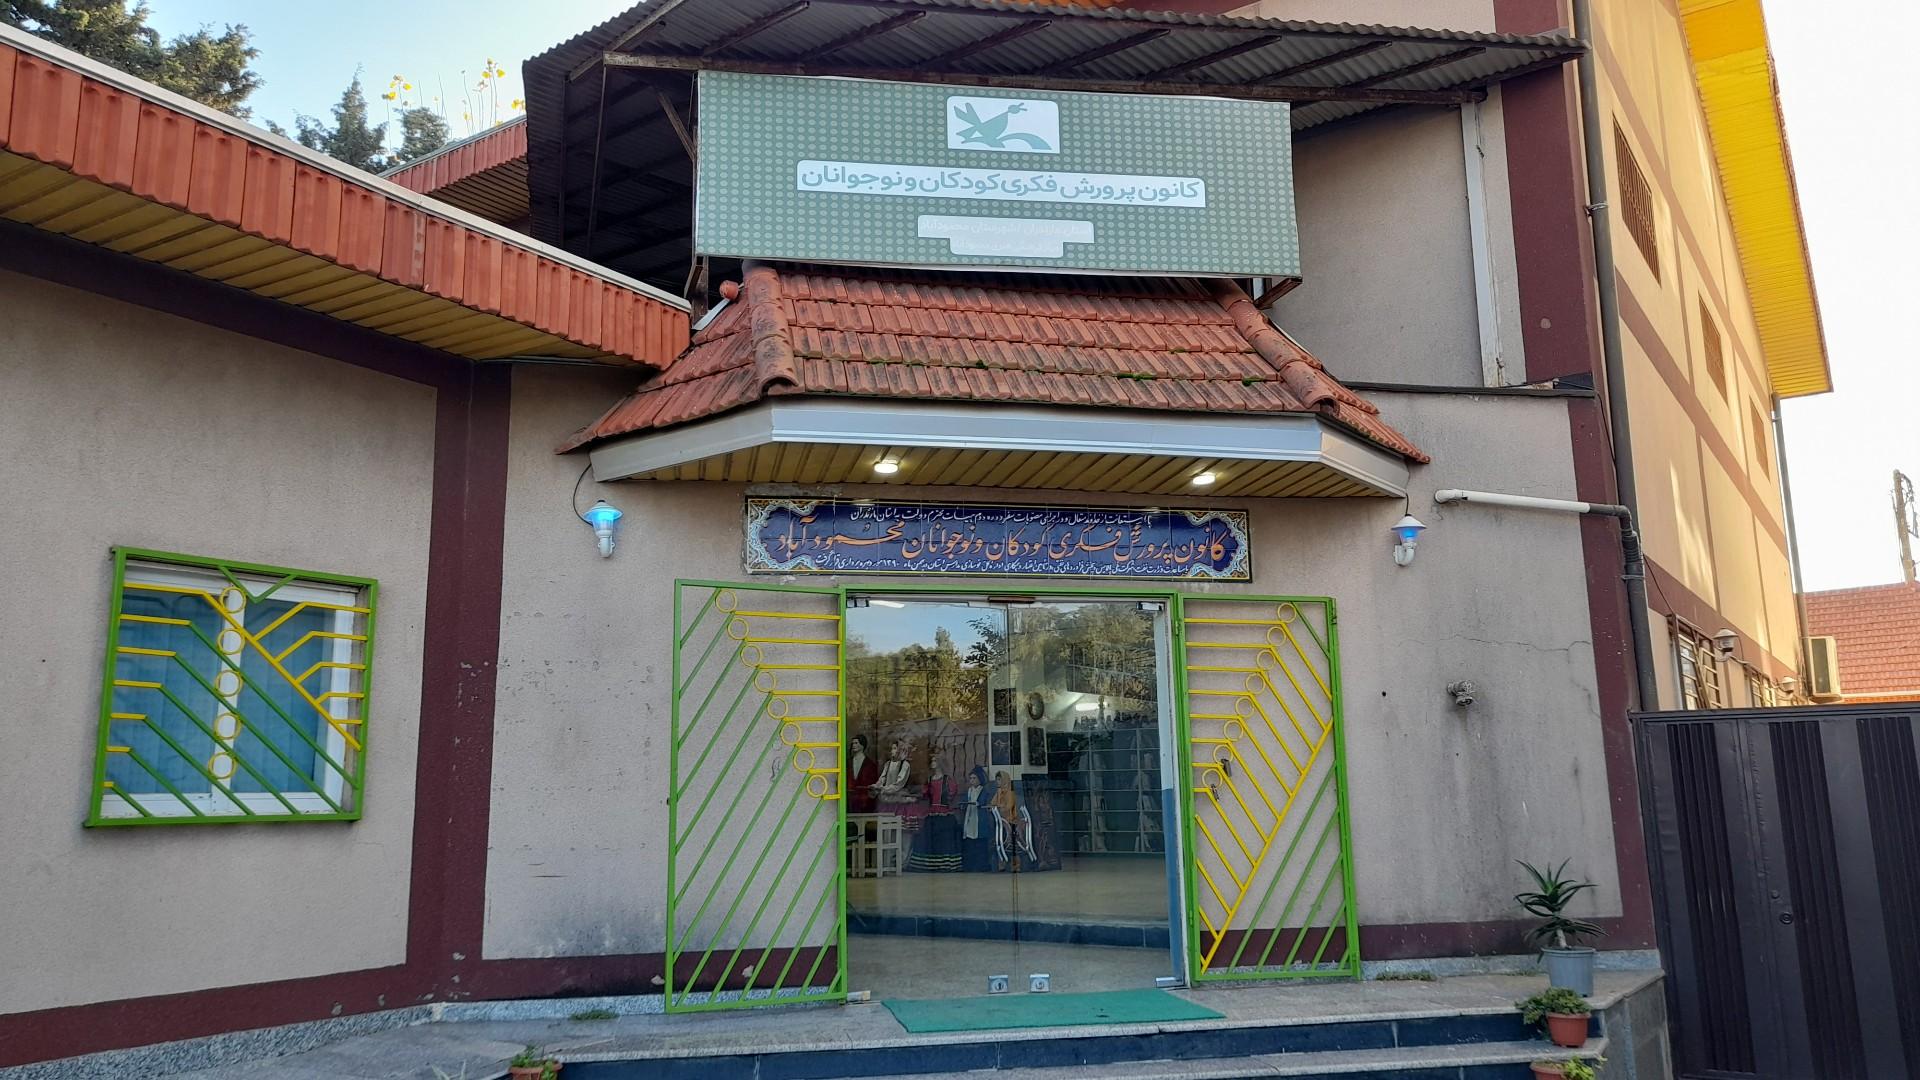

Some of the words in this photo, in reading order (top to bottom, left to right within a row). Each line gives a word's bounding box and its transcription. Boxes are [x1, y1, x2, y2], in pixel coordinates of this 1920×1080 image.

[801, 164, 903, 191] نوجوانان
[918, 171, 1001, 195] کودکان
[1000, 174, 1058, 197] فکری
[1059, 177, 1136, 203] پرورش
[1137, 181, 1200, 203] کانون
[901, 522, 976, 560] نوجوانان
[985, 520, 1055, 561] کودکان
[1048, 520, 1122, 560] فکری
[1112, 521, 1172, 563] پرورش
[1173, 526, 1229, 563] کانون
